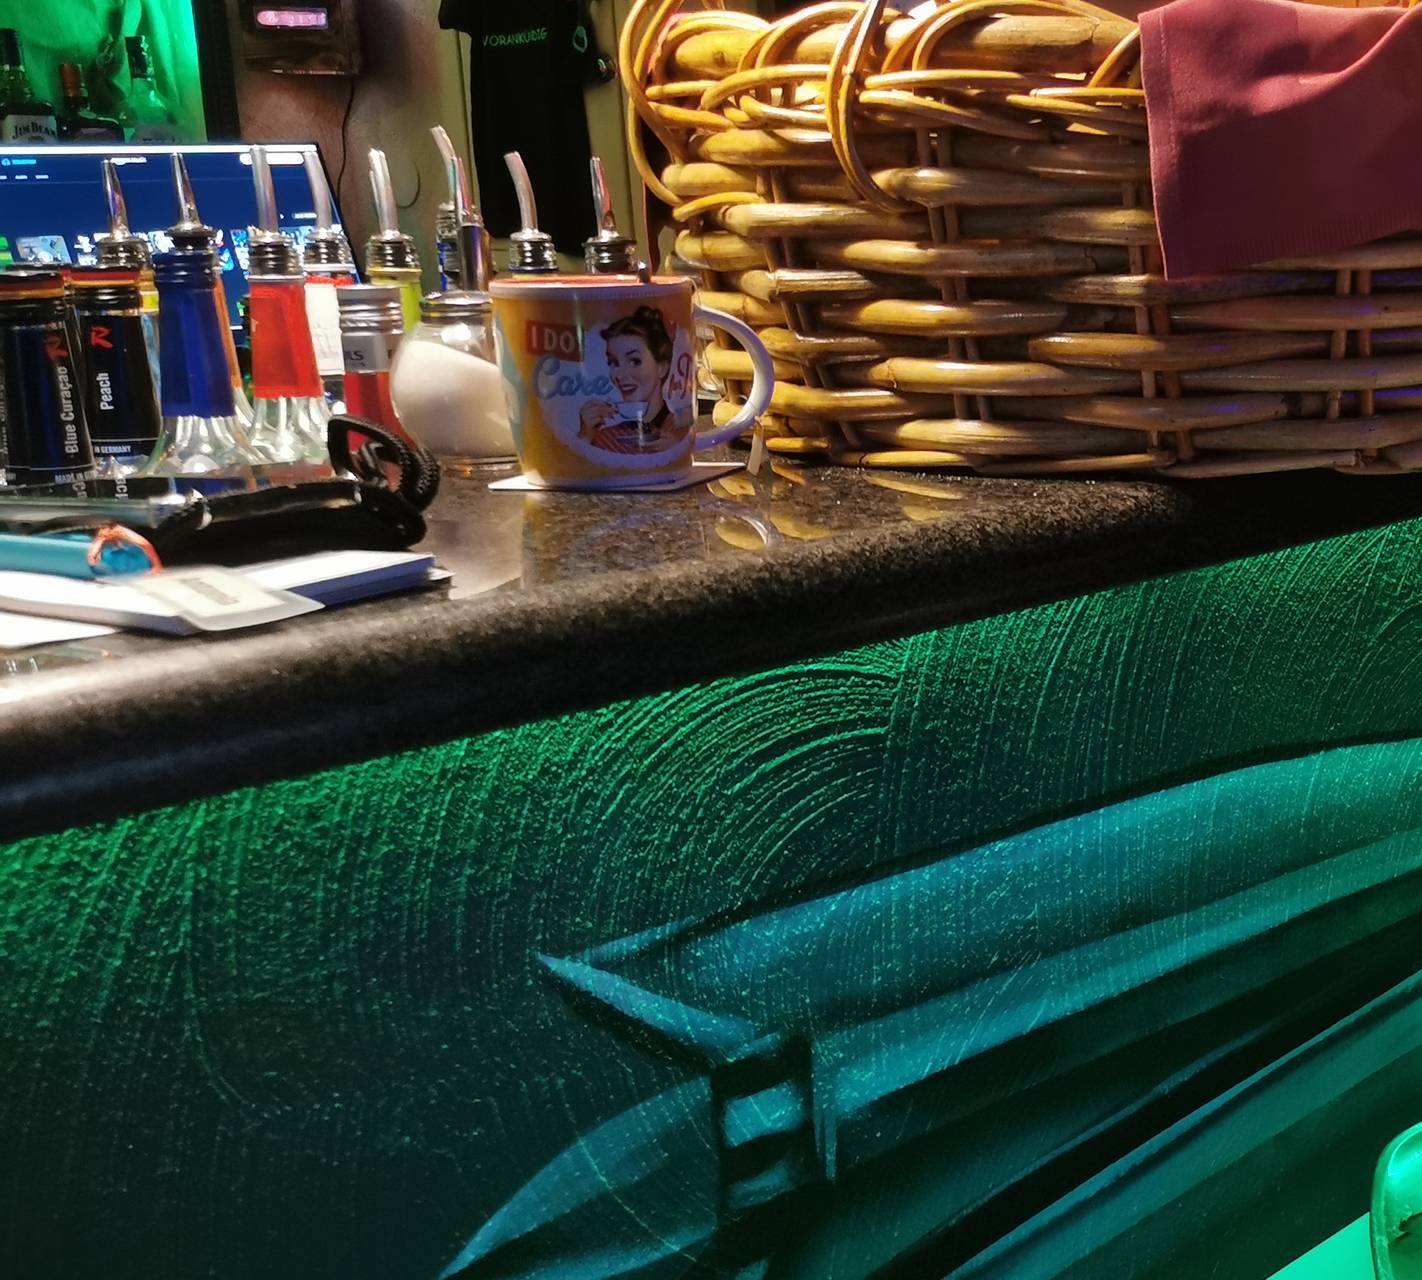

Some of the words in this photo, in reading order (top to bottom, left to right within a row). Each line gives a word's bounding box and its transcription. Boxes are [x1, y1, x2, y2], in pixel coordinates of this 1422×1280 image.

[57, 366, 75, 422] Curaçao
[97, 372, 115, 411] Peach
[533, 354, 614, 400] Care
[64, 424, 80, 455] Blue
[101, 445, 131, 454] GERMANY
